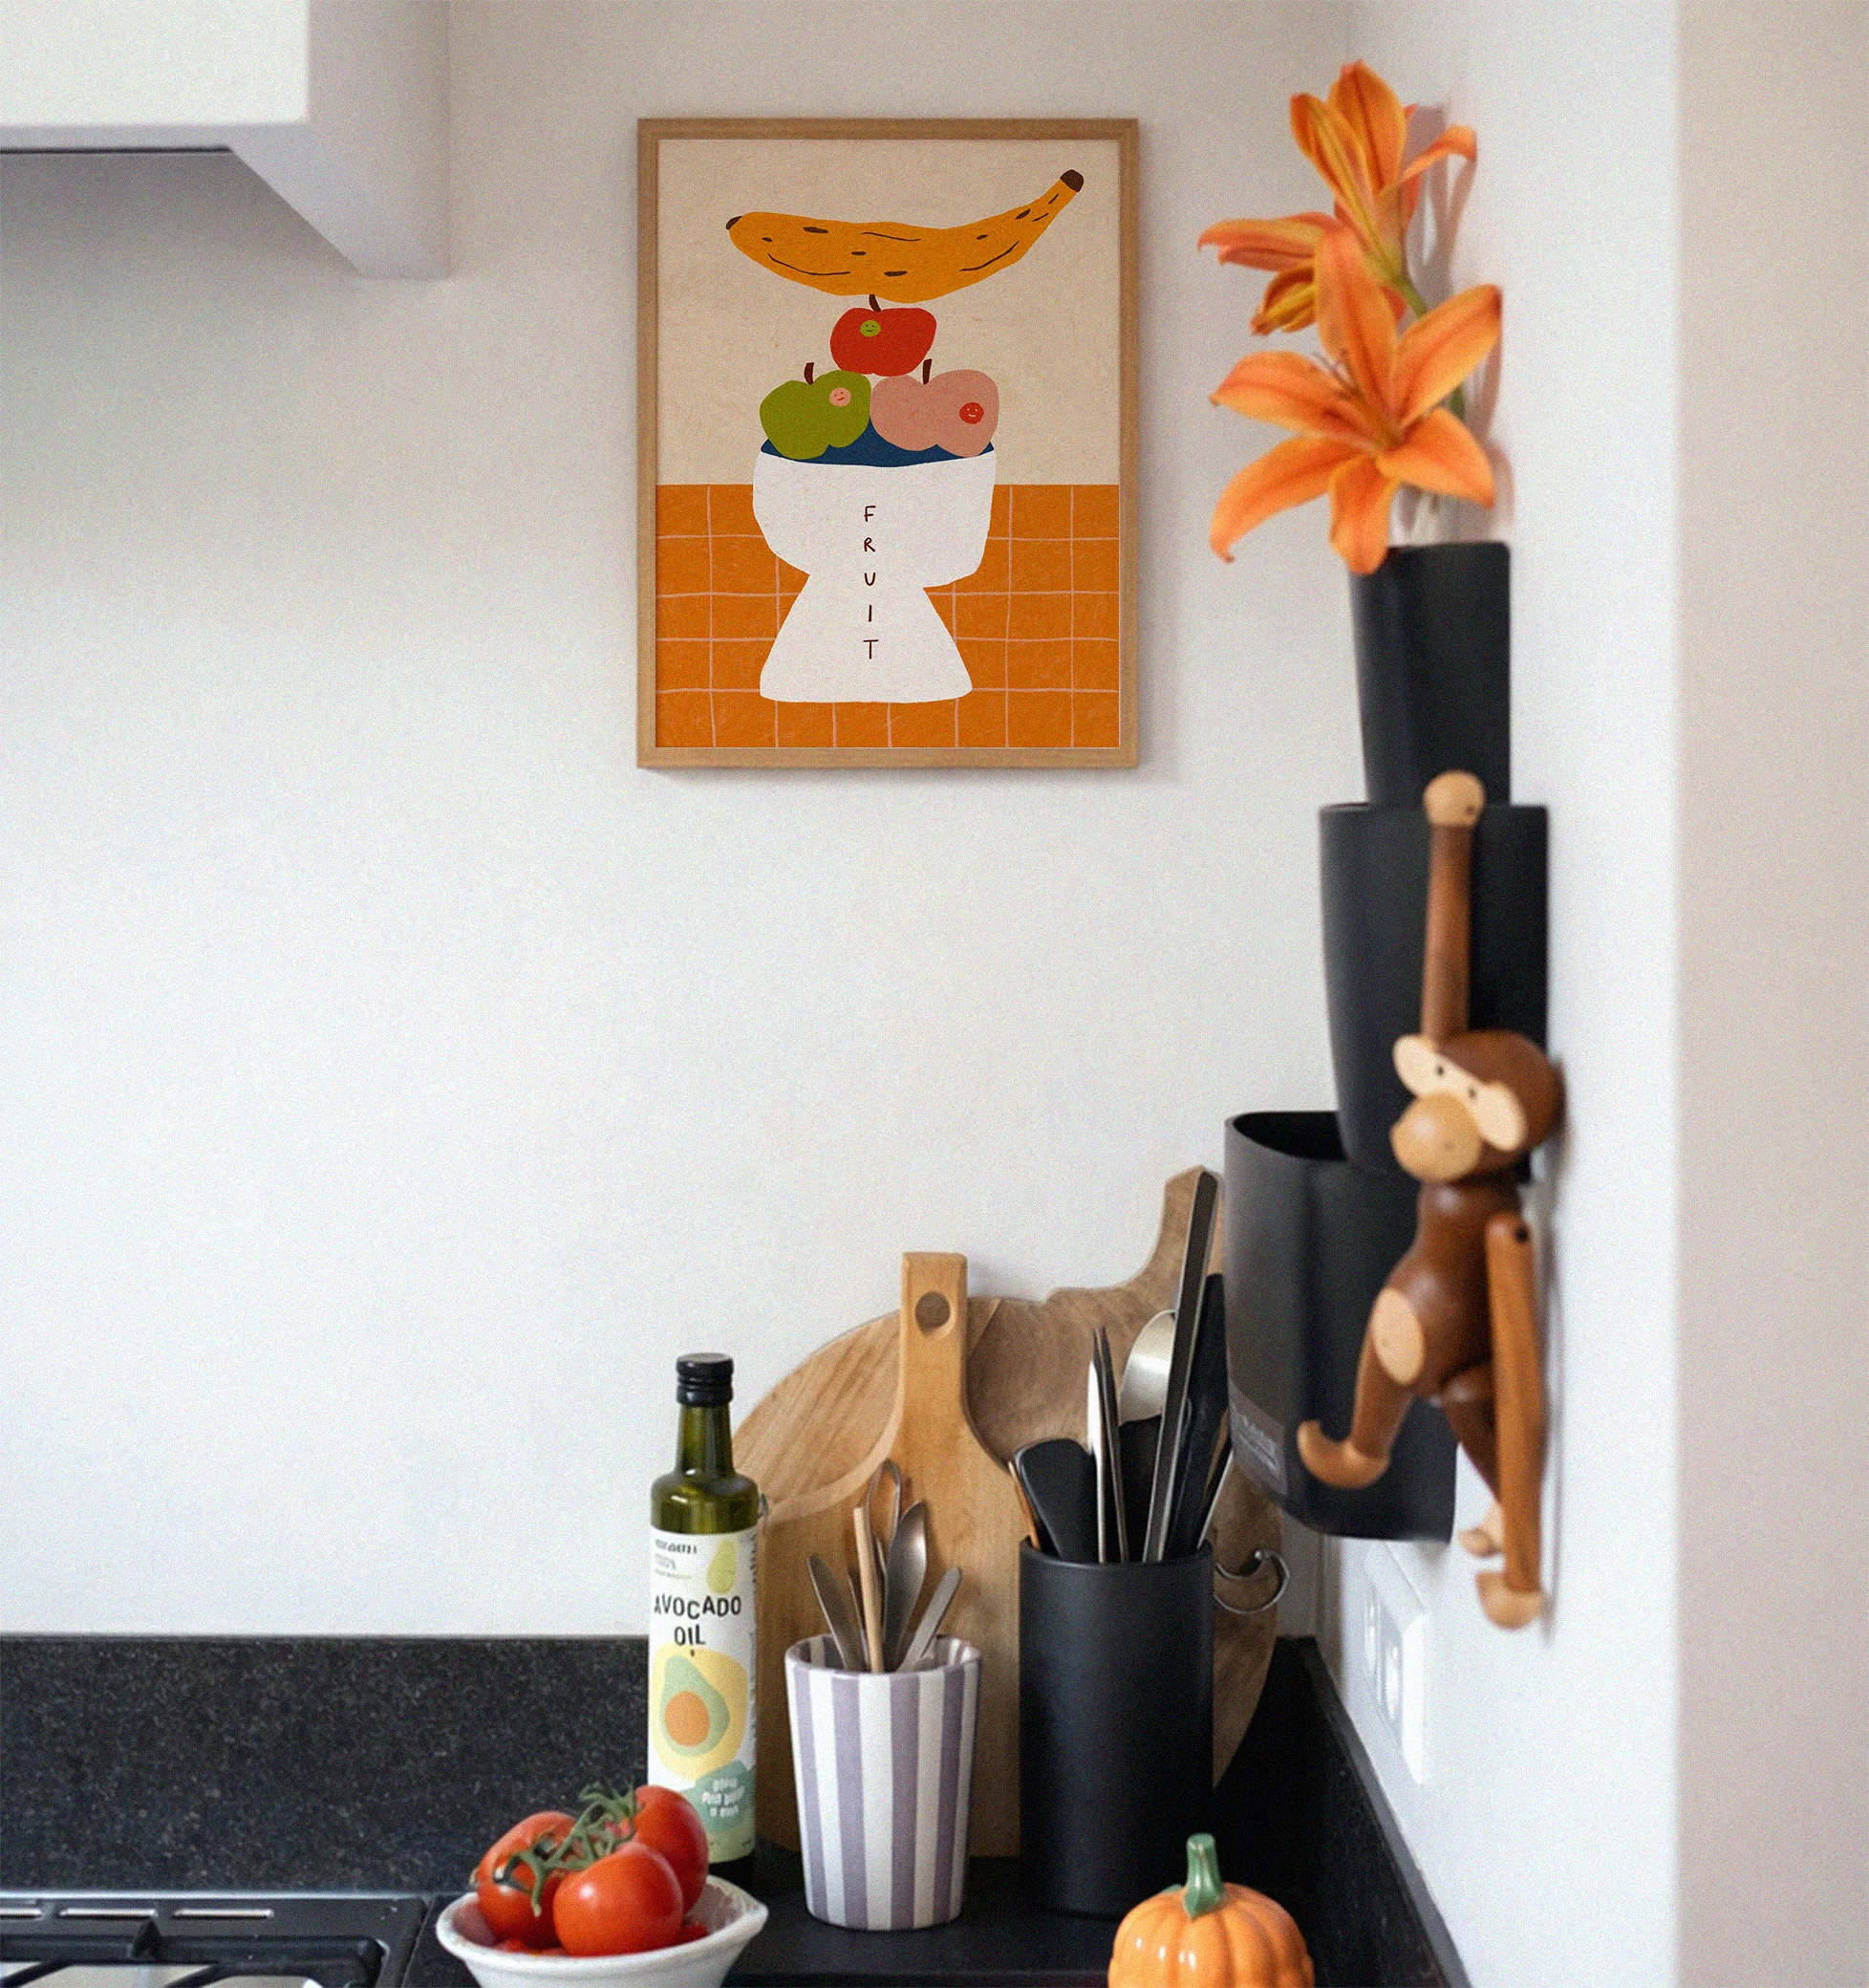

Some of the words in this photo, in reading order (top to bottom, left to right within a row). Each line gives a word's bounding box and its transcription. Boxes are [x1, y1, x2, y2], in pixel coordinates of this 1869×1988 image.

[863, 505, 879, 659] FRUIT
[654, 1593, 741, 1620] AVOCADO
[674, 1624, 706, 1646] OIL
